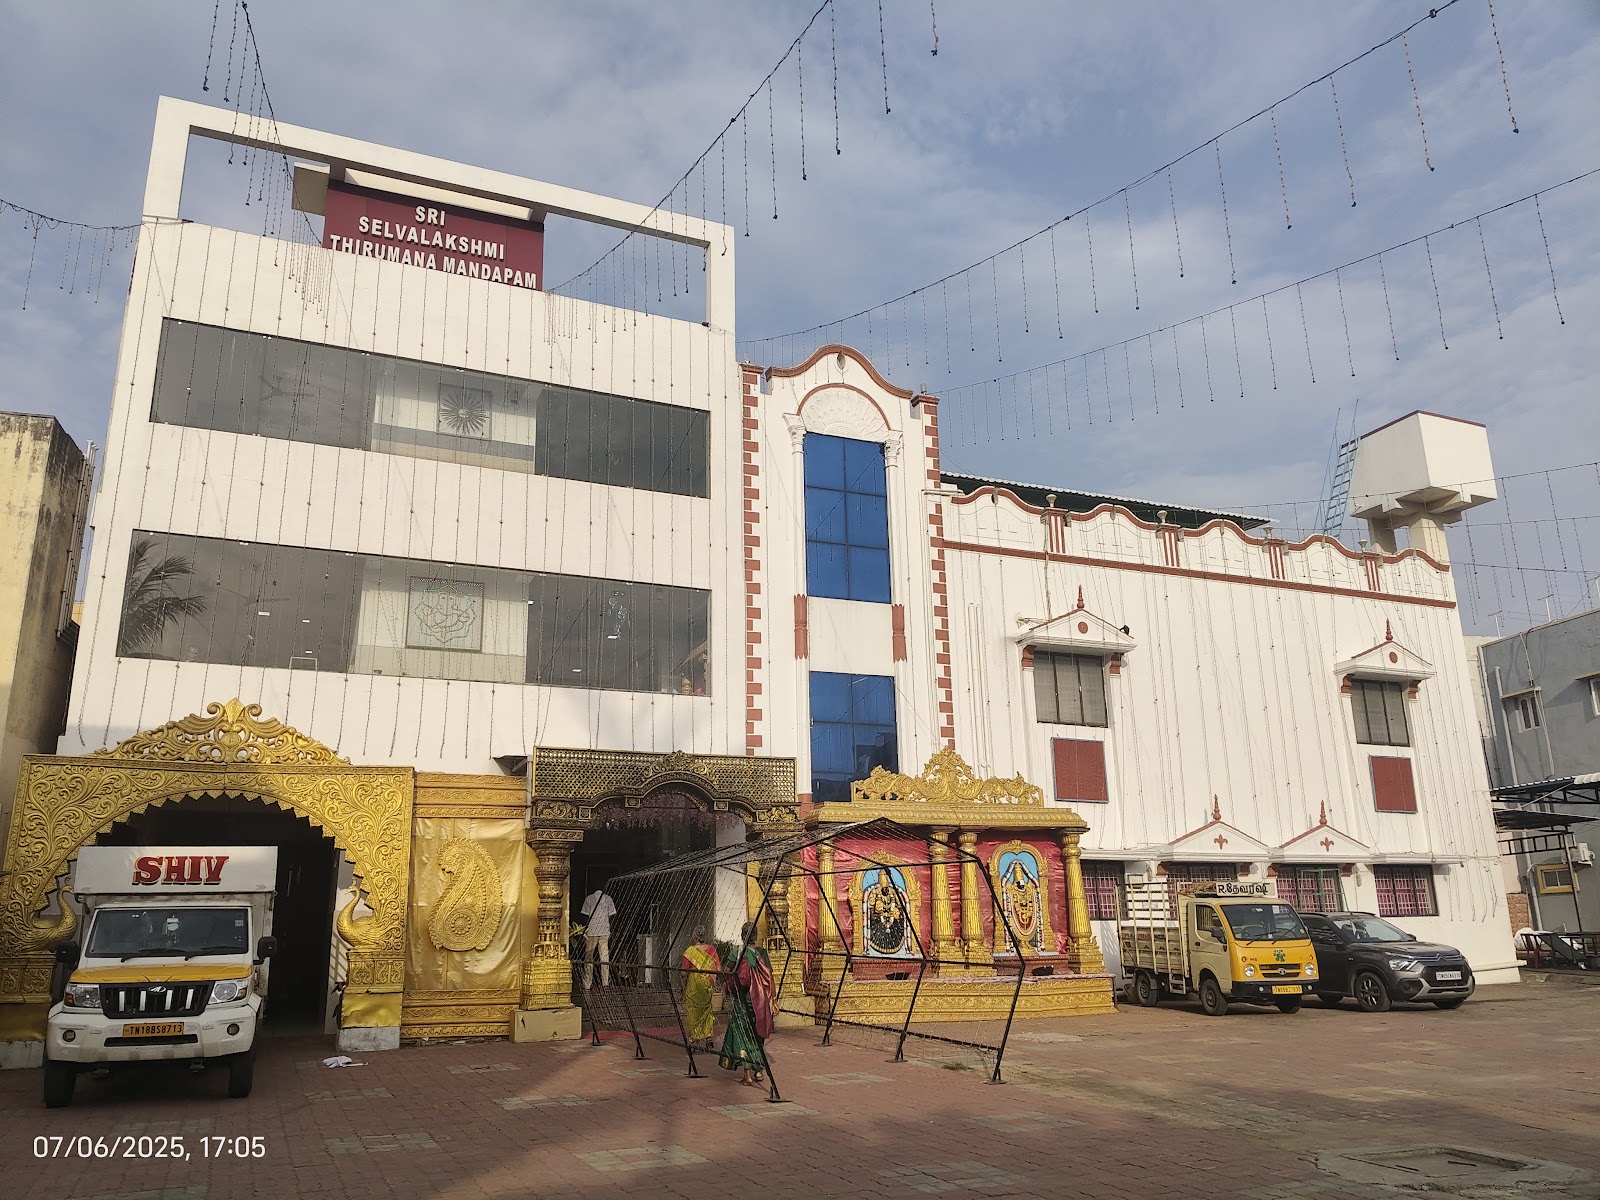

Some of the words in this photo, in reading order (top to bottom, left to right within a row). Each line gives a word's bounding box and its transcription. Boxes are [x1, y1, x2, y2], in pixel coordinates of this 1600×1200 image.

[415, 206, 446, 226] SRI
[358, 216, 505, 260] SELVALAKSHMI
[330, 234, 437, 270] THIRUMANA
[443, 255, 537, 289] MANDAPAM
[132, 855, 230, 885] SHIV
[129, 1024, 183, 1035] TN18BS8713
